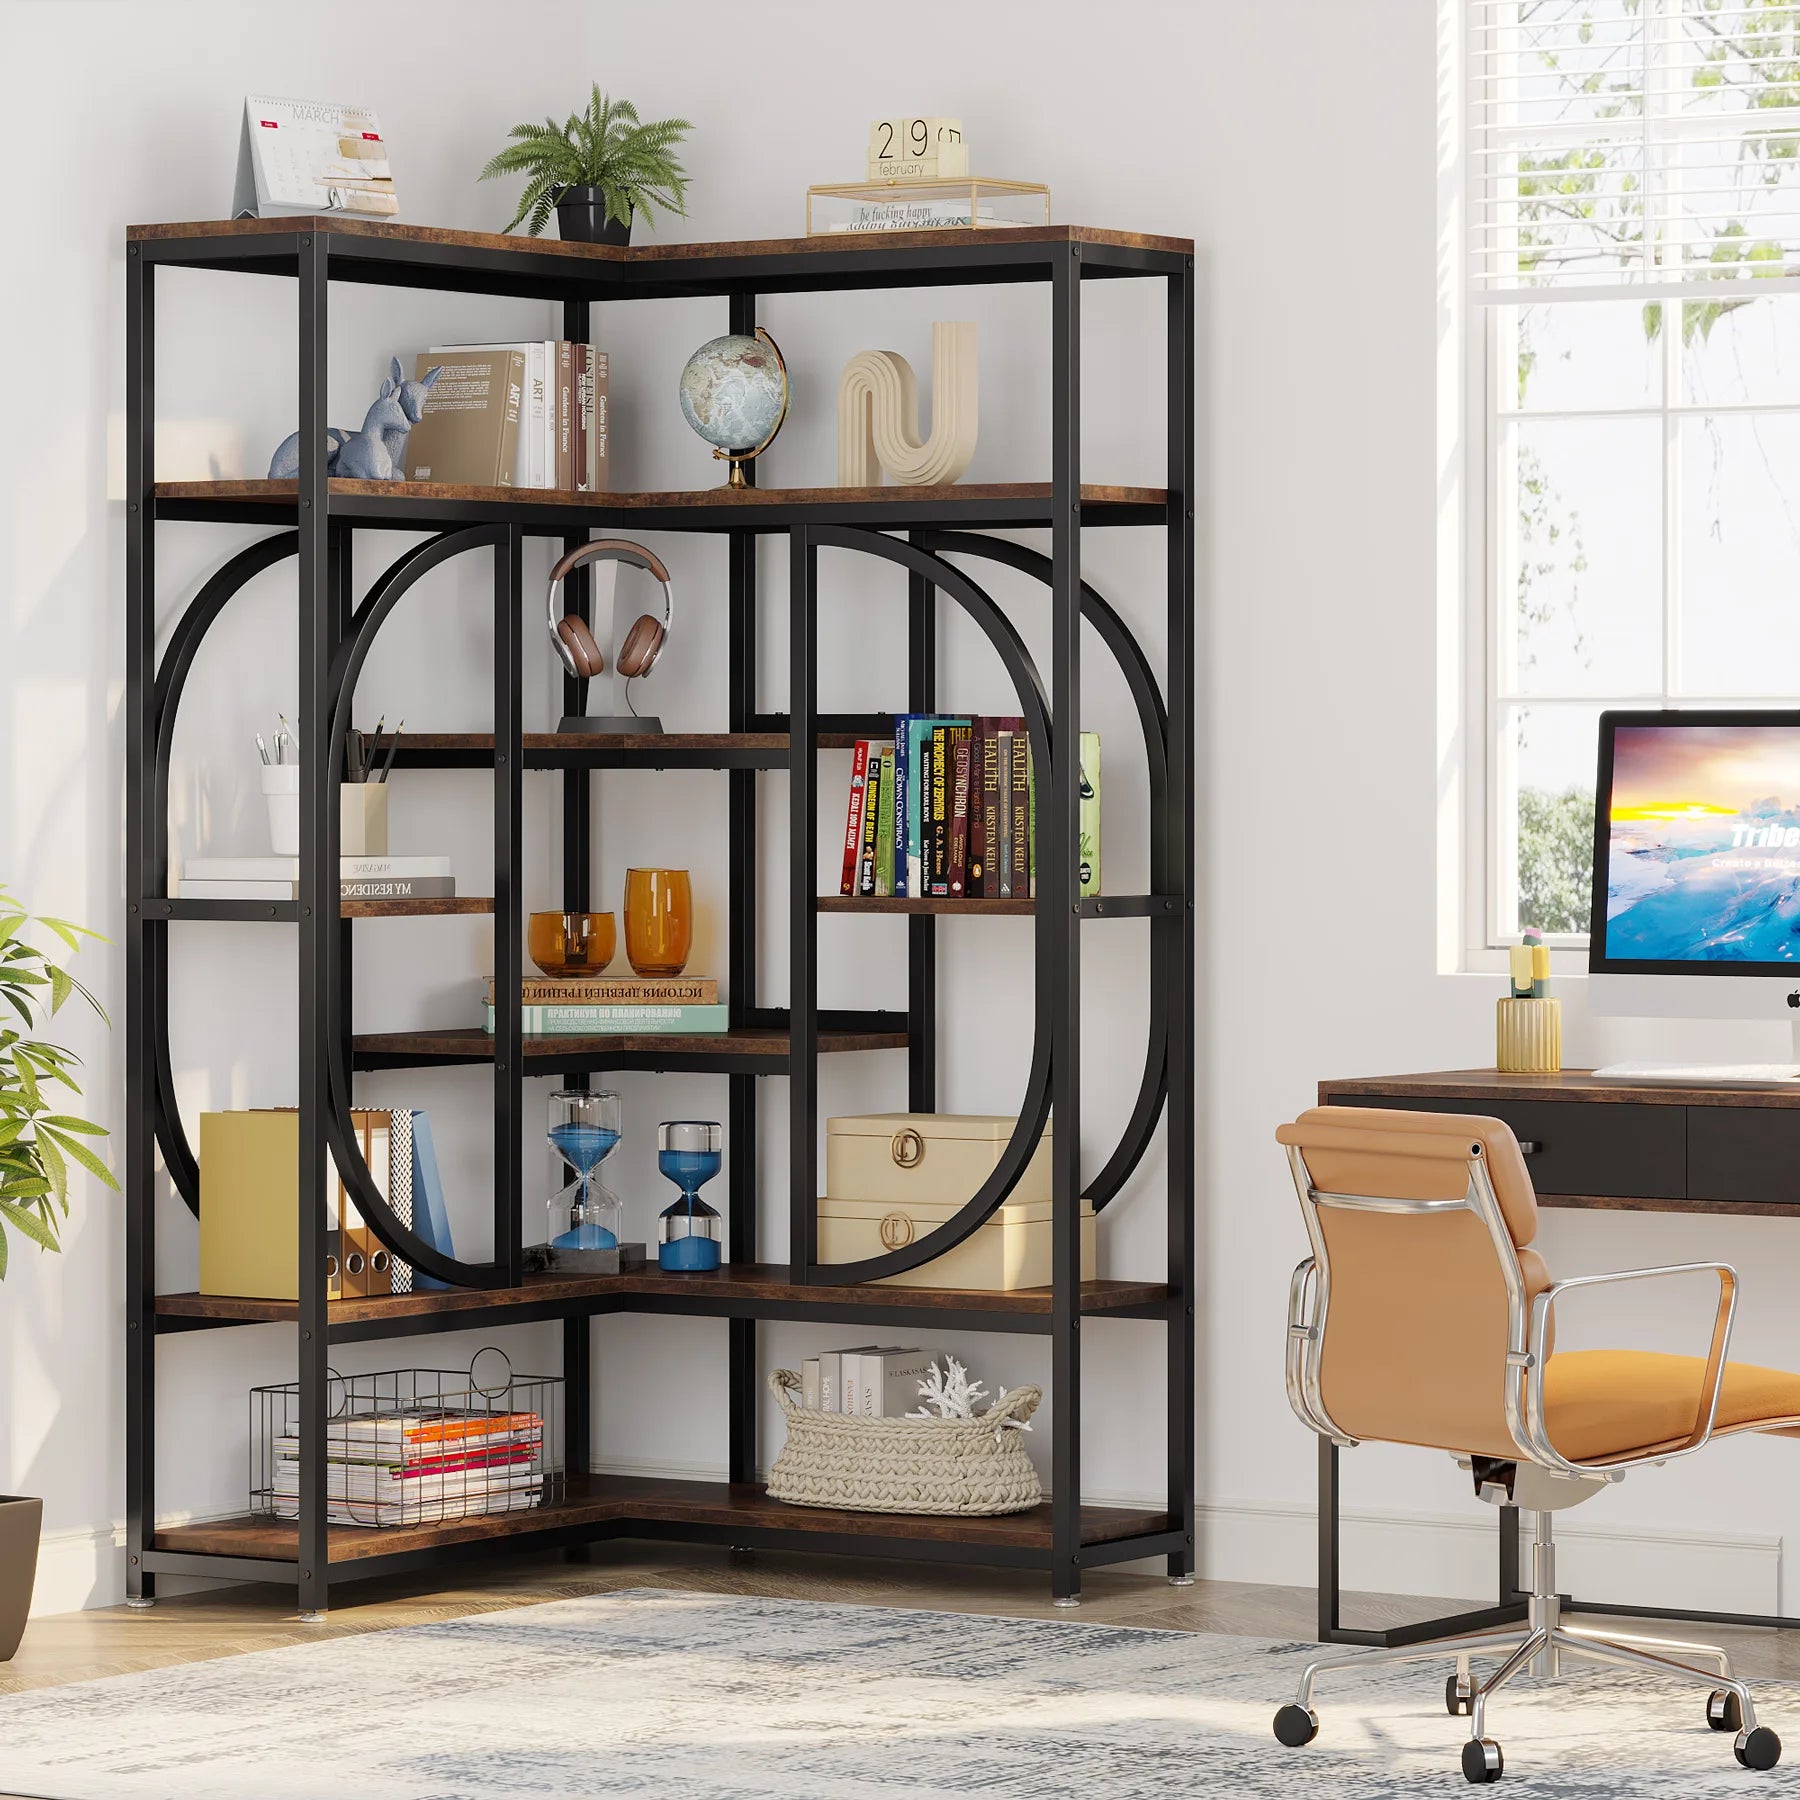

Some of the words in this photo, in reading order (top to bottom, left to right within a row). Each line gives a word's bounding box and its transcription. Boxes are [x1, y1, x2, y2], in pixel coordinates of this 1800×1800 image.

[292, 107, 340, 125] MARCH
[879, 161, 925, 177] february
[860, 207, 870, 222] be
[872, 204, 904, 222] fucking
[906, 203, 933, 220] happy
[508, 383, 521, 408] ART
[533, 378, 543, 402] ART
[562, 386, 570, 417] Gardens
[599, 395, 607, 425] Gardens
[562, 418, 570, 426] in
[599, 425, 607, 433] in
[562, 427, 570, 453] France
[599, 433, 607, 458] France
[933, 728, 945, 742] THE
[933, 742, 945, 777] PROPHECY
[985, 738, 999, 792] HALITH
[1013, 738, 1027, 792] HALITH
[895, 767, 904, 800] CROWN
[933, 777, 945, 787] OF
[954, 748, 969, 818] GEOSYNCHRON
[850, 792, 861, 813] KEDAI
[866, 780, 878, 811] DUNGEON
[933, 787, 945, 821] ZEPHYRUS
[849, 813, 858, 827] 1001
[866, 812, 875, 821] OF
[895, 800, 904, 850] CONSPIRACY
[985, 806, 996, 843] KIRSTEN
[1014, 806, 1025, 843] KIRSTEN
[846, 827, 856, 850] MIMPI
[864, 821, 874, 843] DEATH
[935, 825, 943, 837] G.
[1731, 822, 1800, 848] Tribe
[935, 838, 943, 849] A.
[863, 861, 873, 875] Scott
[935, 850, 943, 875] Hesse
[985, 847, 996, 872] KELLY
[1014, 847, 1025, 873] KELLY
[1711, 858, 1753, 868] Create
[532, 987, 582, 999] ГРЕЦИИ
[586, 987, 640, 1000] ДРЕВНЕЙ
[643, 987, 702, 998] ИСТОРИЯ
[547, 1008, 598, 1018] ПРАКТИКУМ
[599, 1008, 610, 1018] ПО
[822, 1375, 830, 1398] HOME
